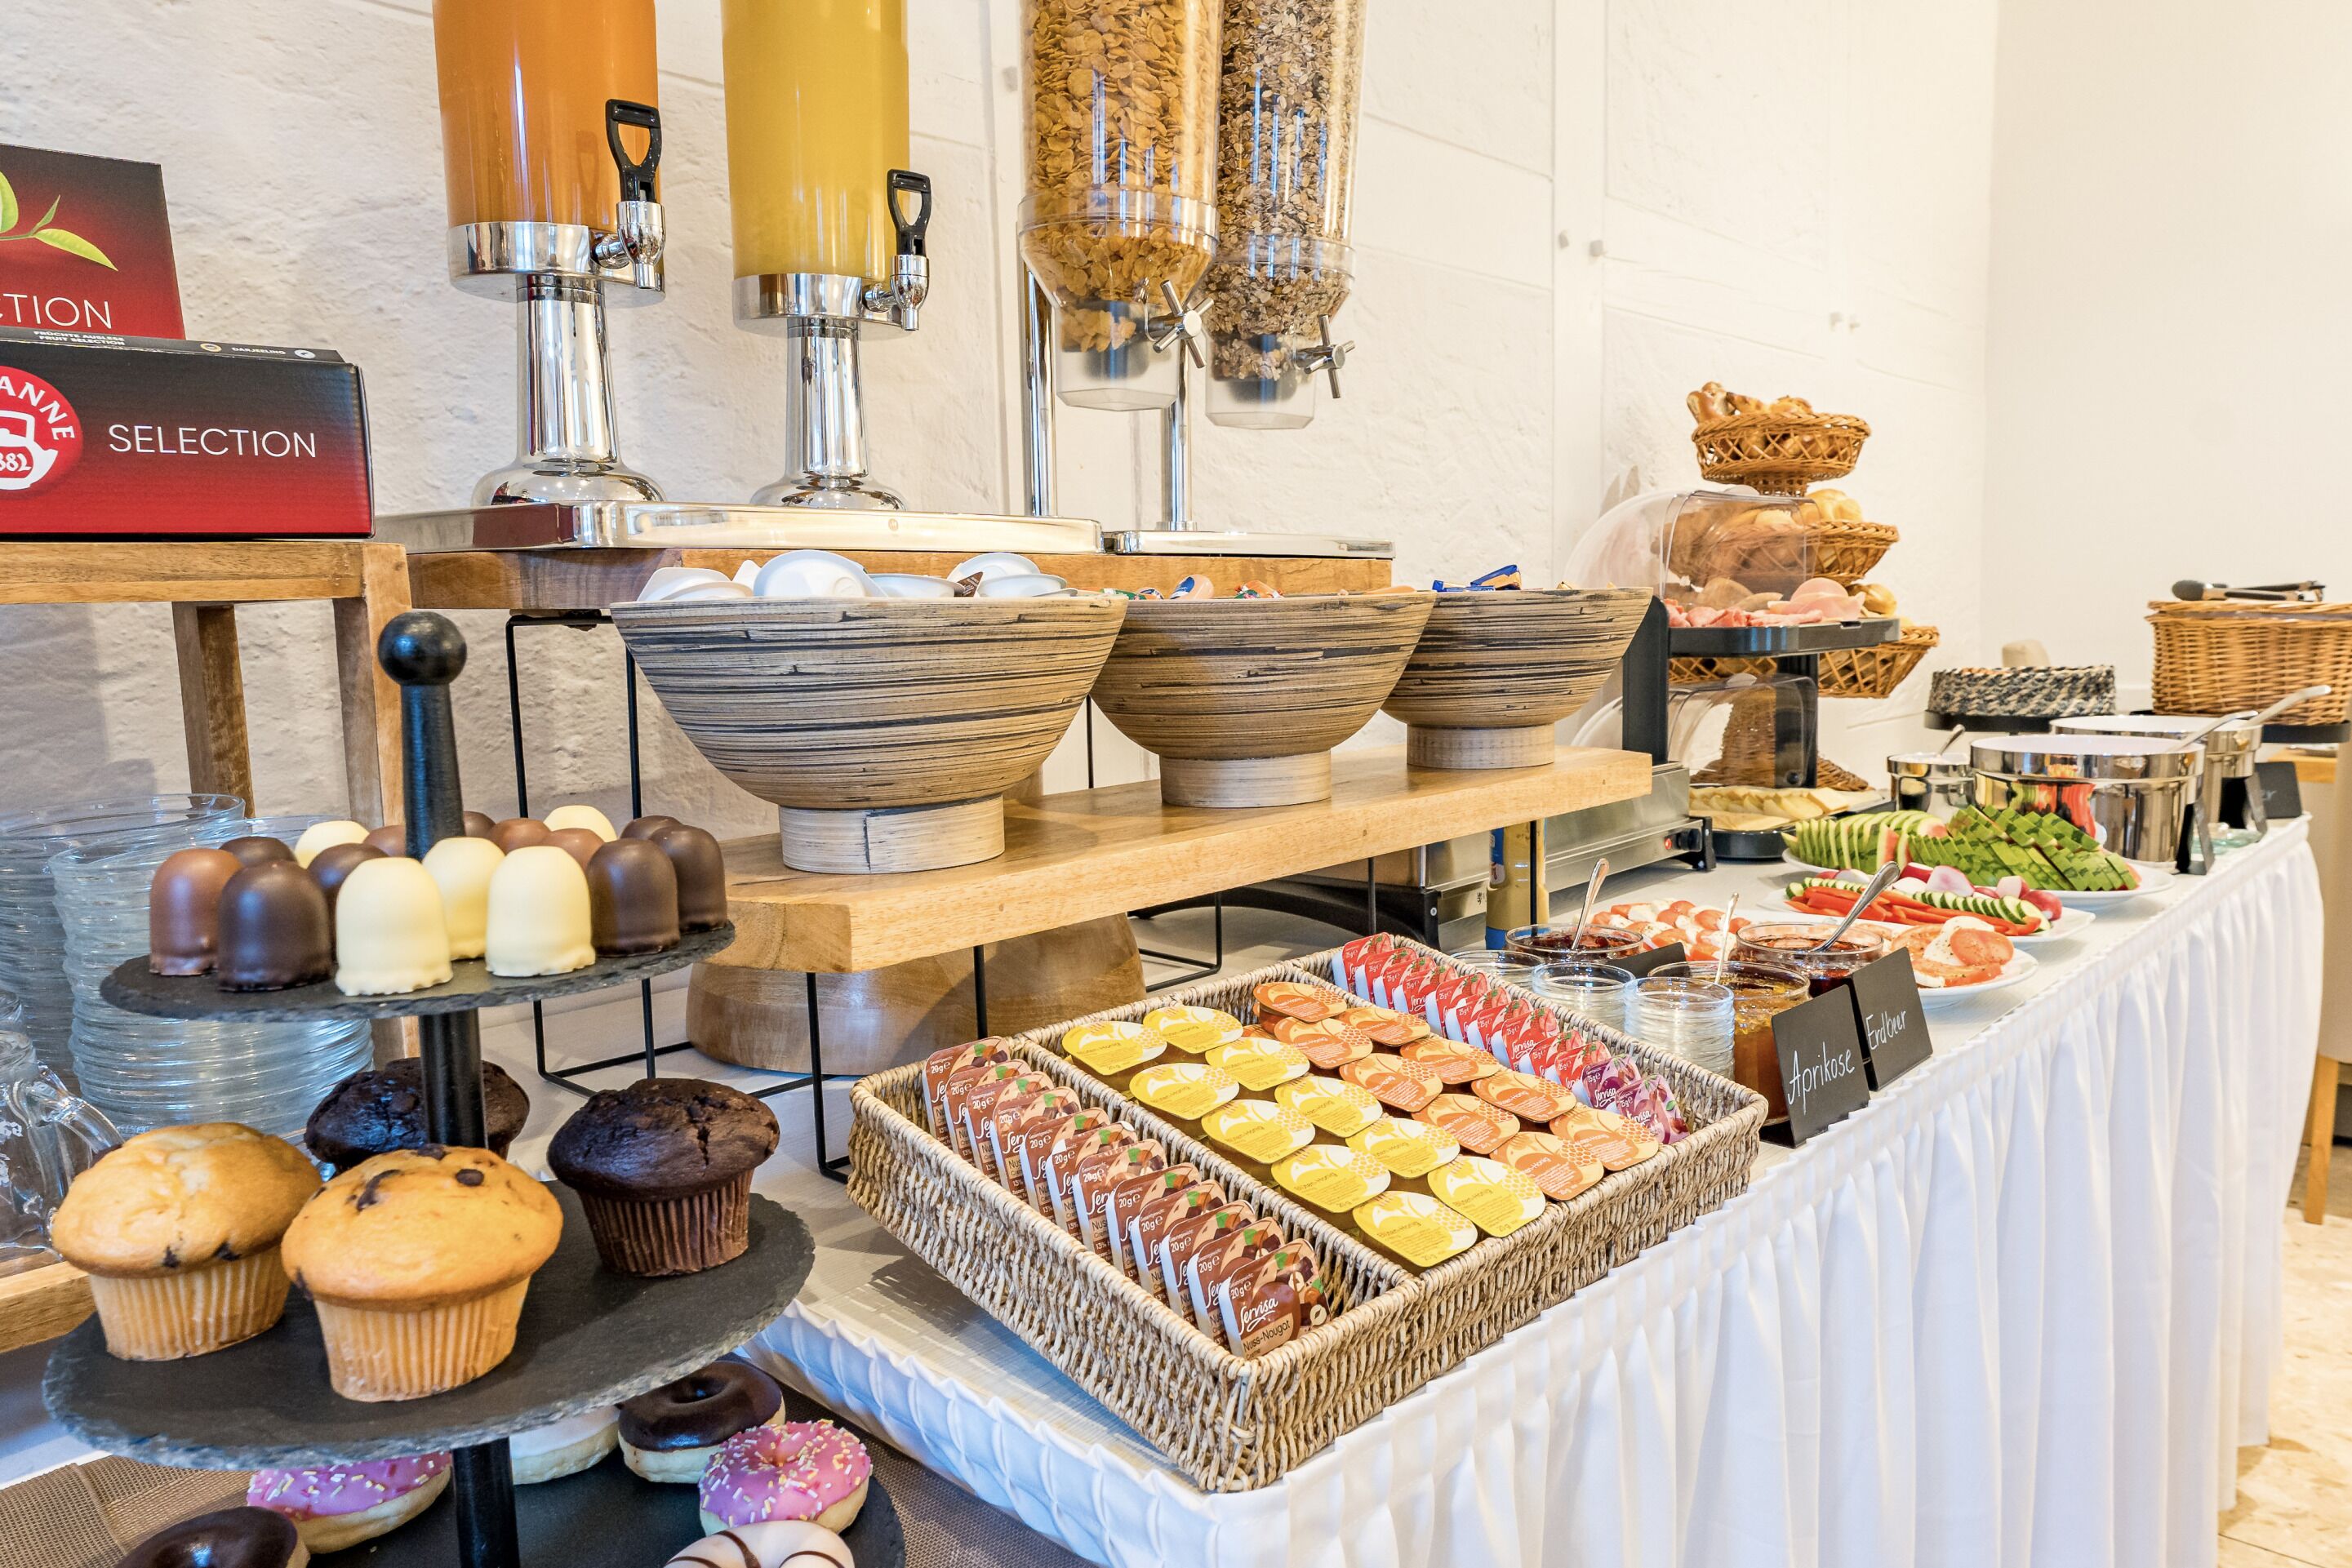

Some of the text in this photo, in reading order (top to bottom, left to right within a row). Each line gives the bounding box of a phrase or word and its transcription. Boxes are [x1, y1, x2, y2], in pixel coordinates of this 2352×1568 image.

[0, 293, 112, 329] TION
[109, 424, 317, 459] SELECTION
[1865, 1011, 1906, 1051] Erdbeer
[1787, 1041, 1855, 1116] Aprikose
[1238, 1298, 1278, 1335] Servisa
[1243, 1319, 1291, 1352] Nuss-Nougat
